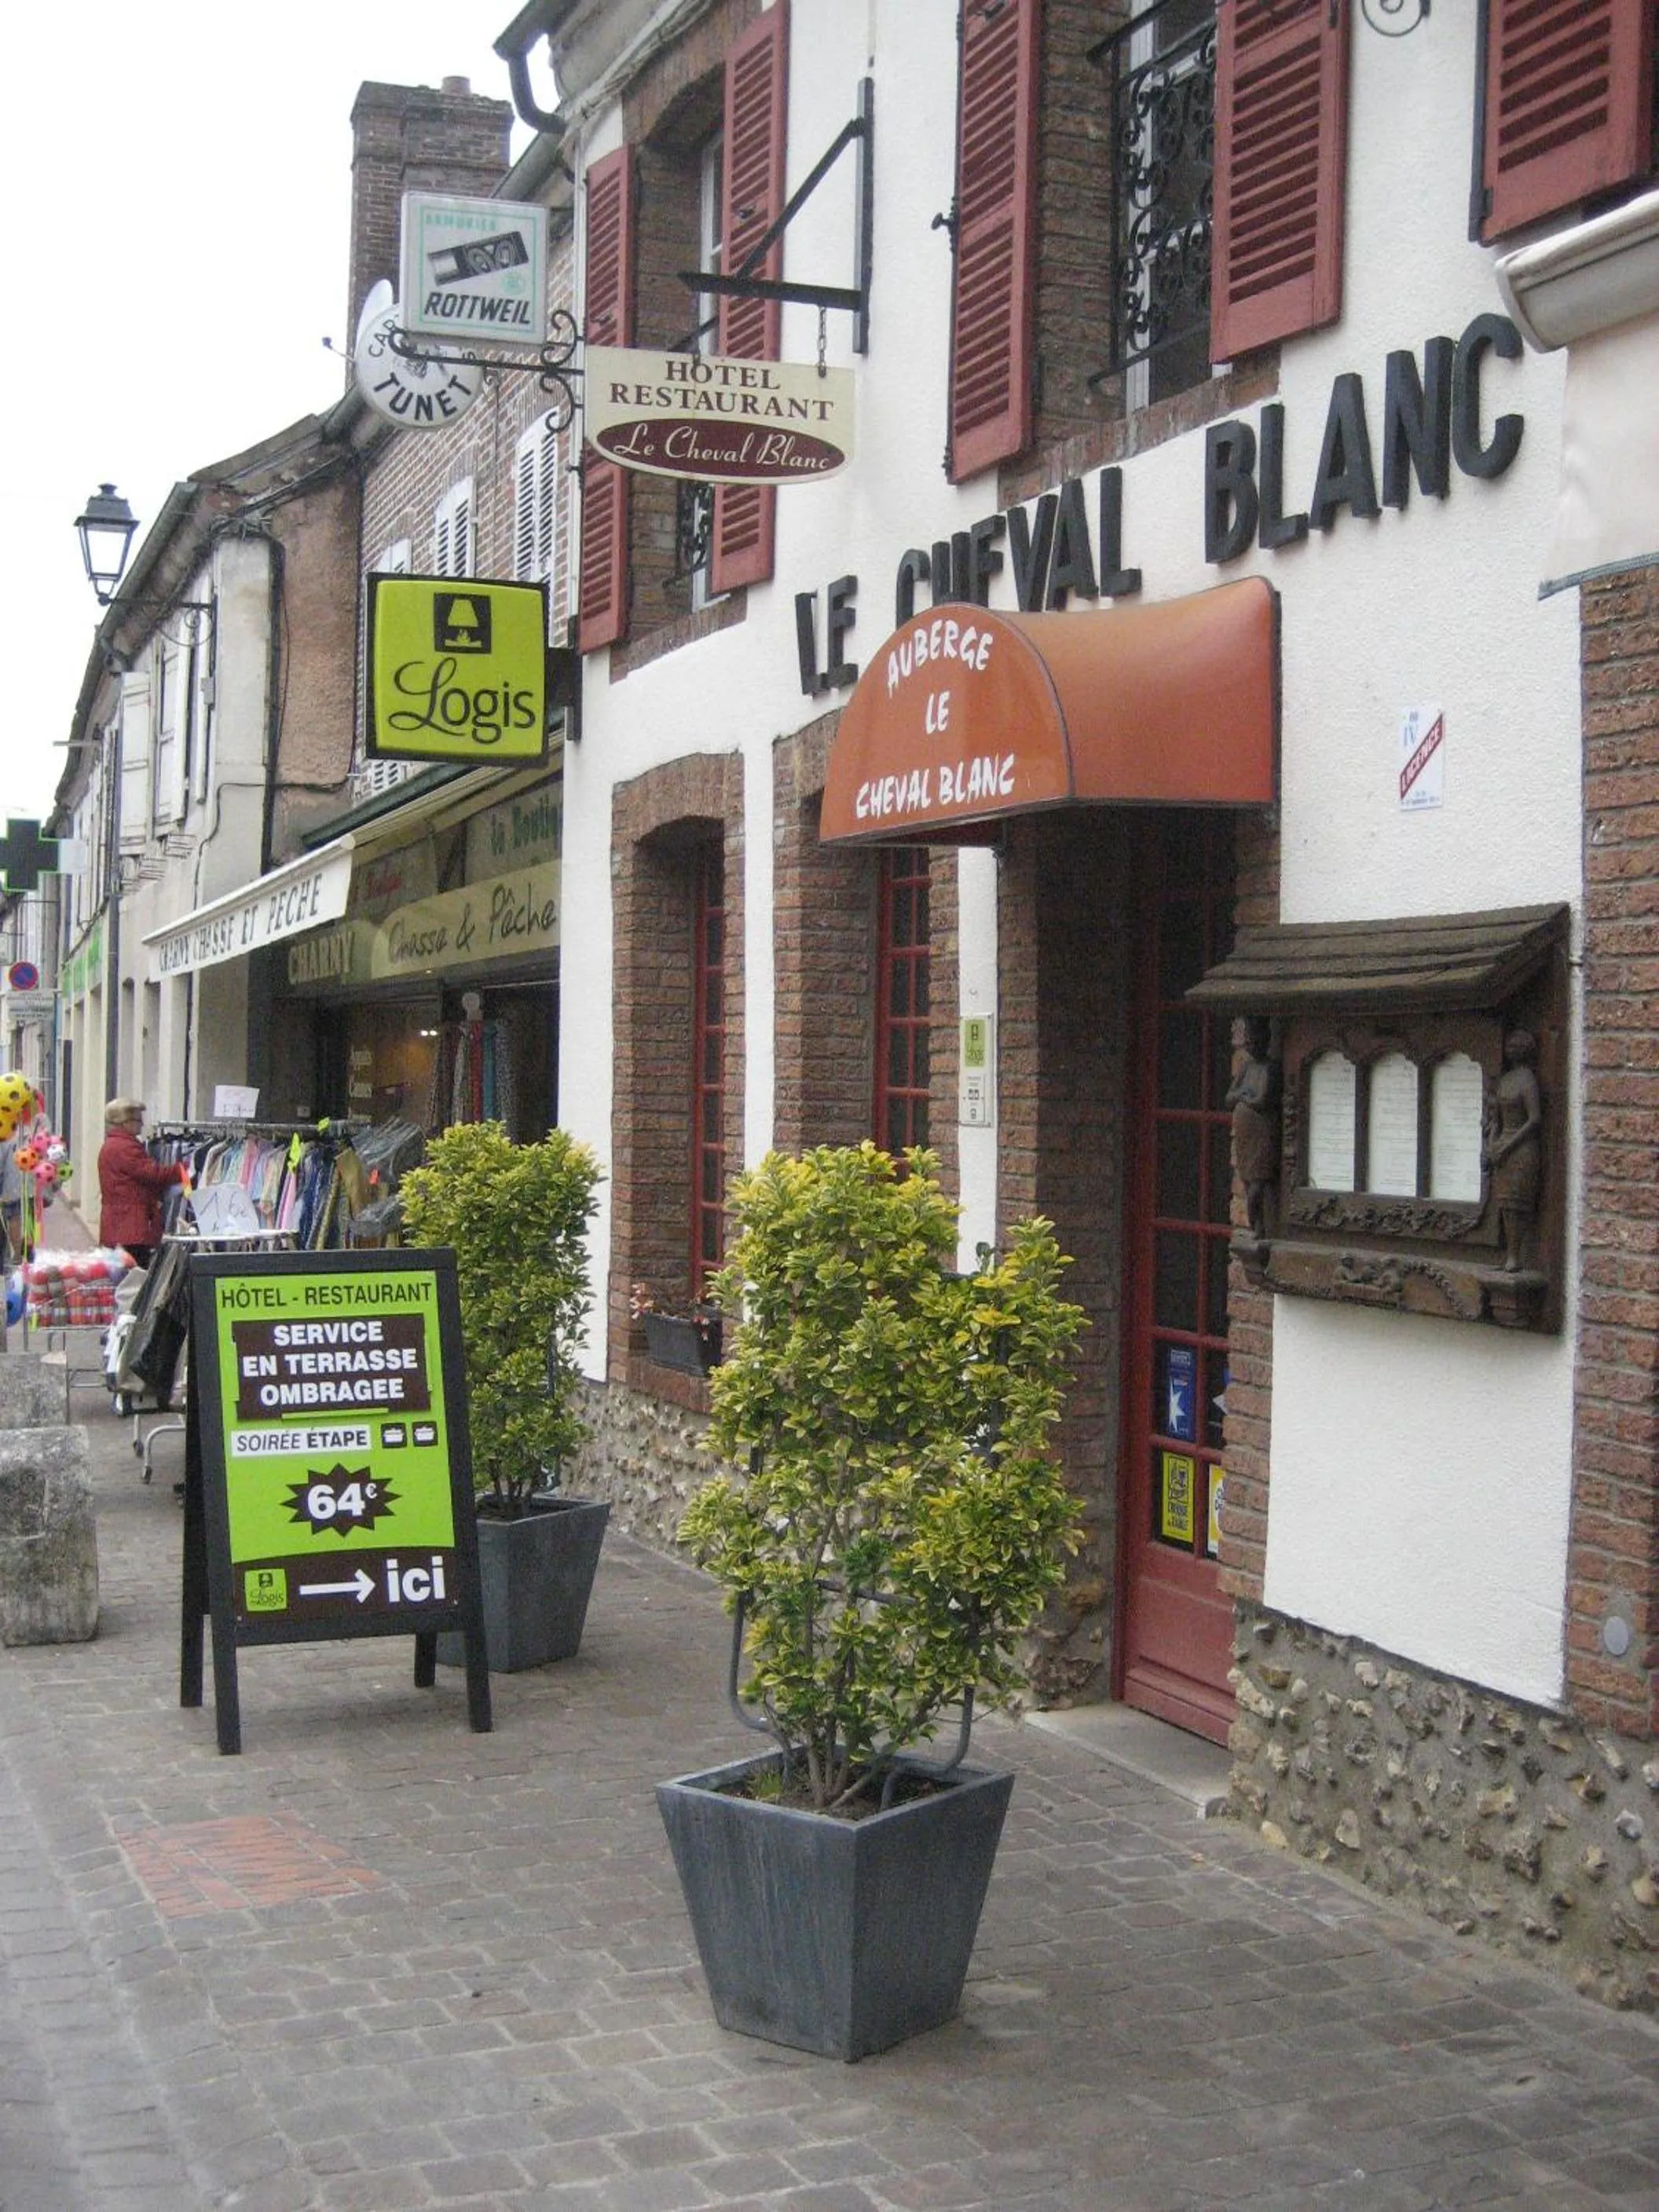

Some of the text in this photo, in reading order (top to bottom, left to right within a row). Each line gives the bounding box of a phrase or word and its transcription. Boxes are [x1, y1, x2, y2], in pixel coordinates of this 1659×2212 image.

[423, 291, 531, 325] ROTTWEIL
[373, 372, 472, 422] TUNET
[610, 382, 834, 422] RESTAURANT
[613, 423, 829, 469] Le Cheval Blanc
[795, 574, 859, 696] LE
[1204, 311, 1525, 565] BLANC
[887, 618, 994, 698] AUBERGE
[388, 657, 537, 745] Logis
[925, 690, 950, 734] LE
[855, 752, 1016, 820] CHEVAL BLANC
[241, 905, 259, 945] ET
[266, 873, 322, 935] PECHE
[222, 1283, 287, 1308] HÔTEL
[304, 1283, 432, 1305] RESTAURANT
[273, 1320, 384, 1347] SERVICE
[242, 1348, 418, 1377] EN TERRASSE
[260, 1378, 405, 1407] OMBRAGEE
[236, 1426, 368, 1452] SOIRÉE ÉTAPE
[386, 1555, 447, 1603] ici
